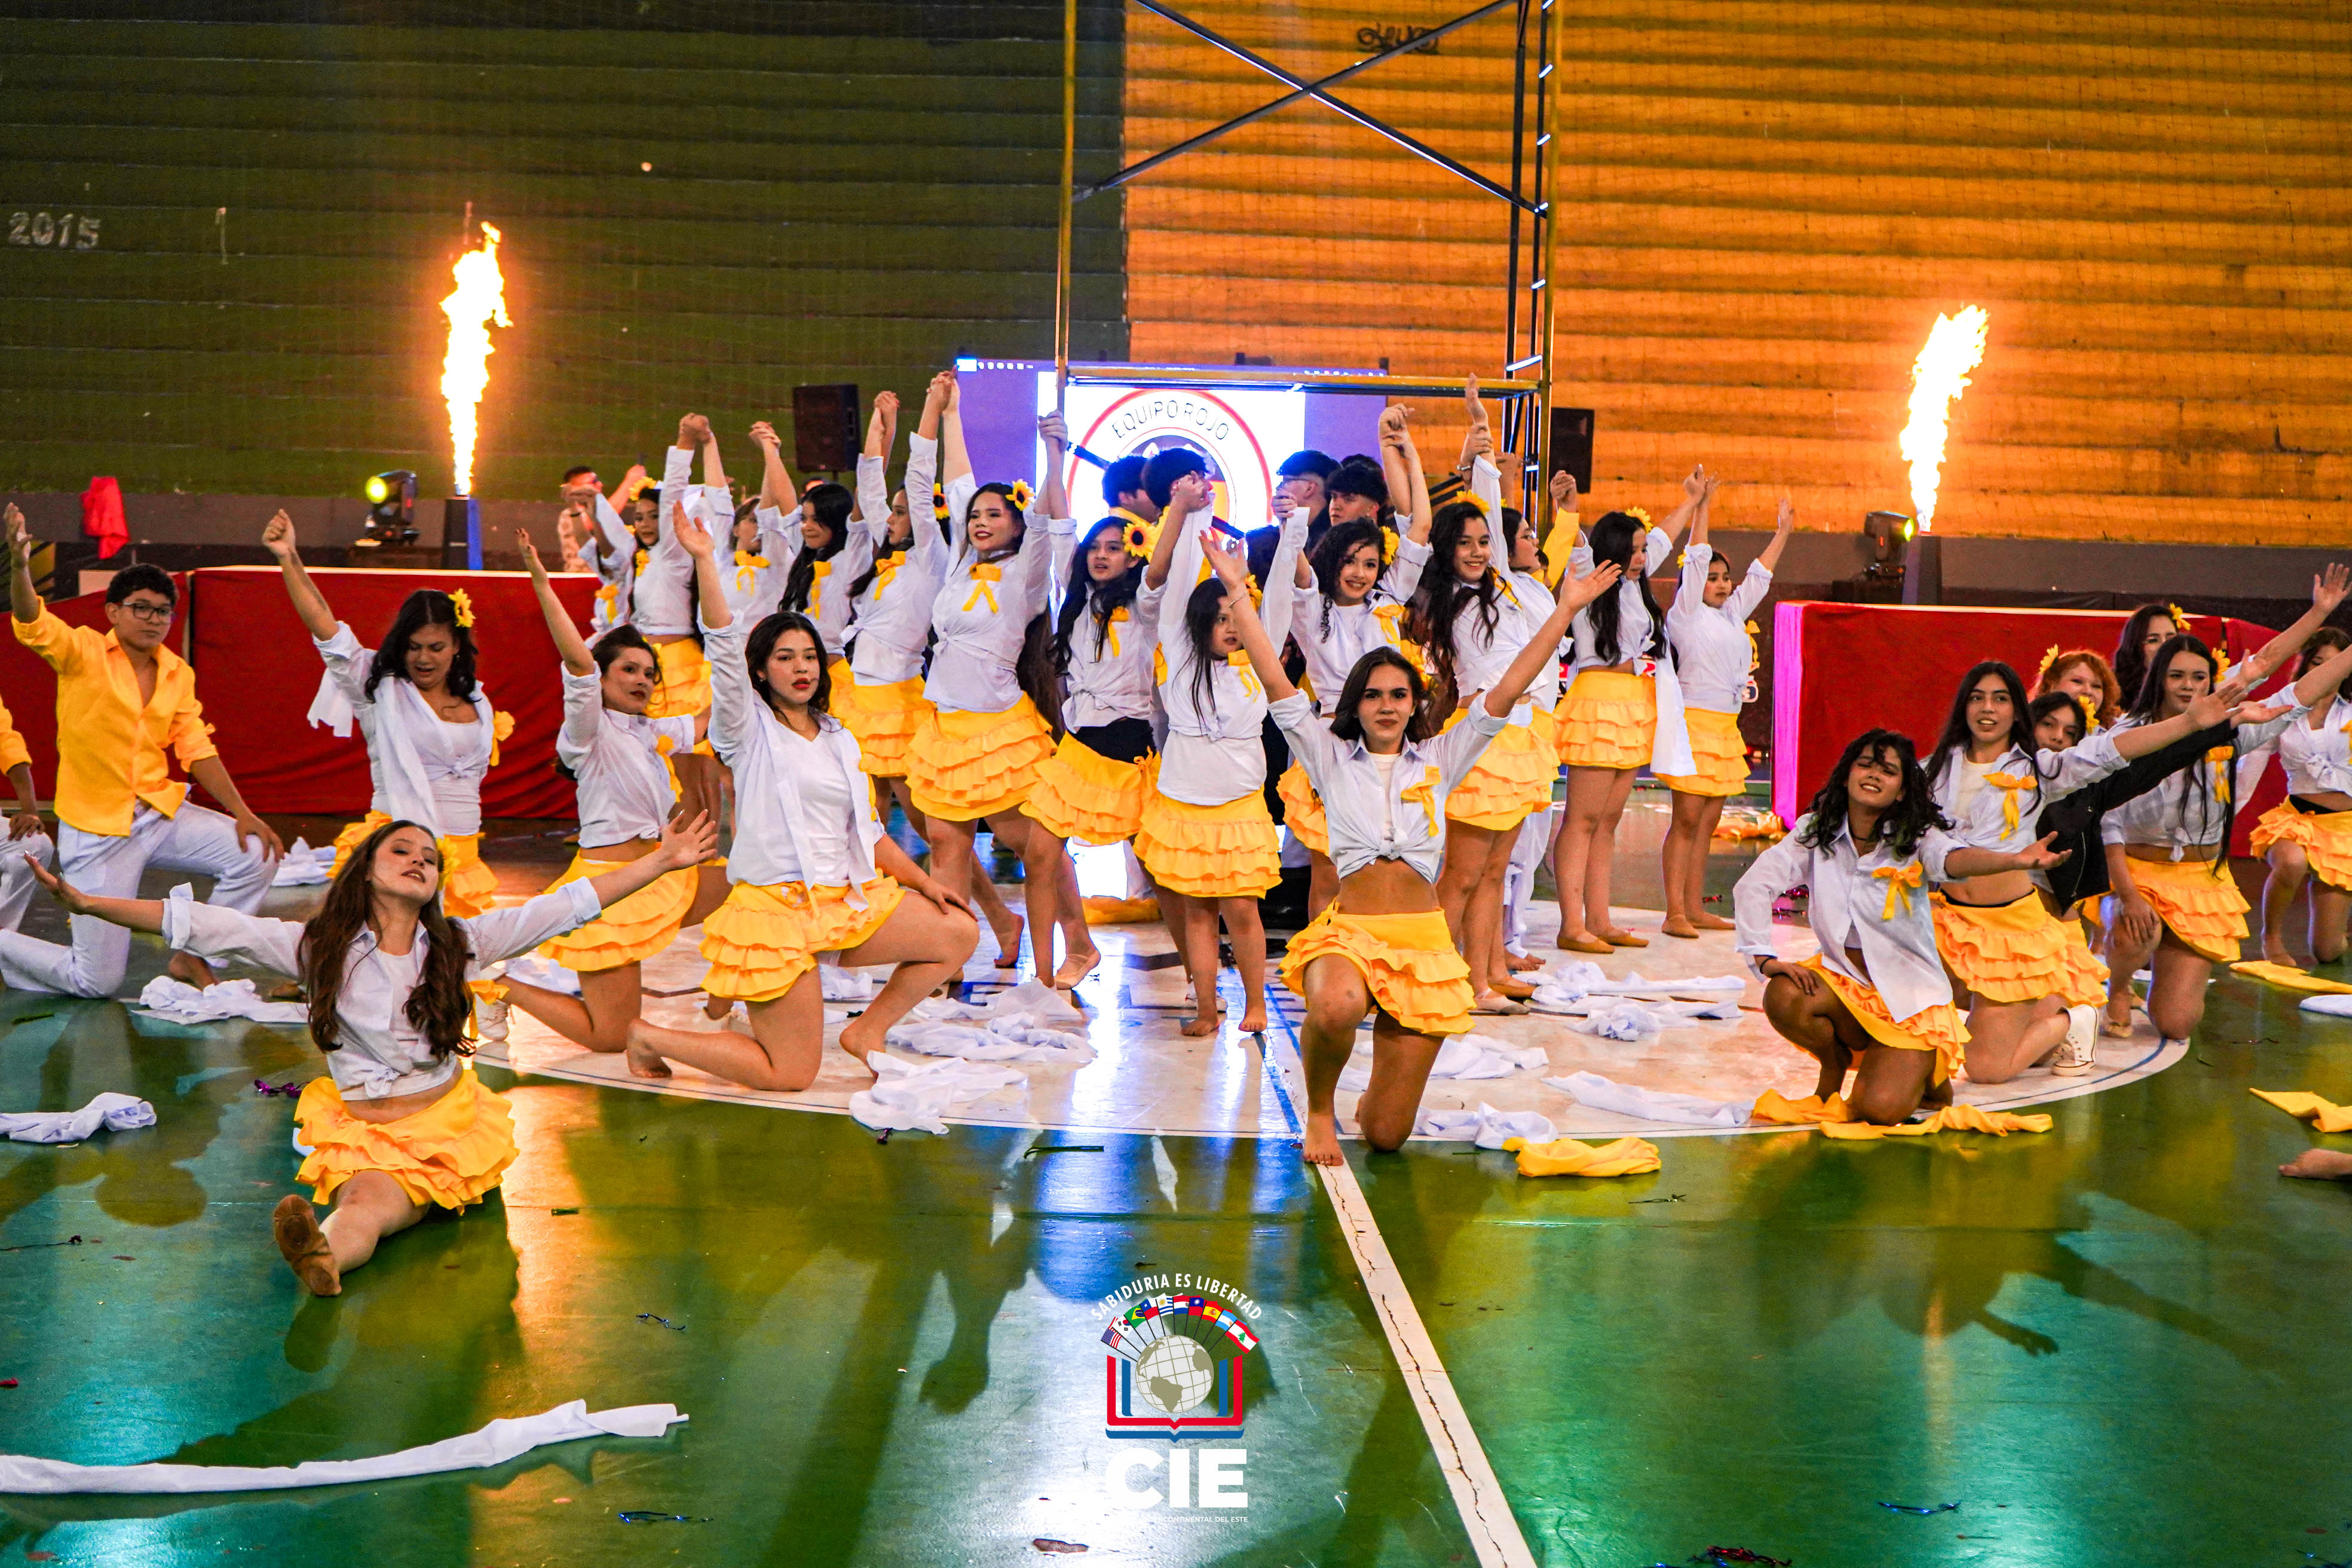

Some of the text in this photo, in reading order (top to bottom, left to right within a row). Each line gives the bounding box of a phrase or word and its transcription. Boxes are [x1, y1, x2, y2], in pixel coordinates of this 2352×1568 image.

[8, 211, 101, 250] 2015
[1111, 400, 1229, 440] EQUIPO ROJO
